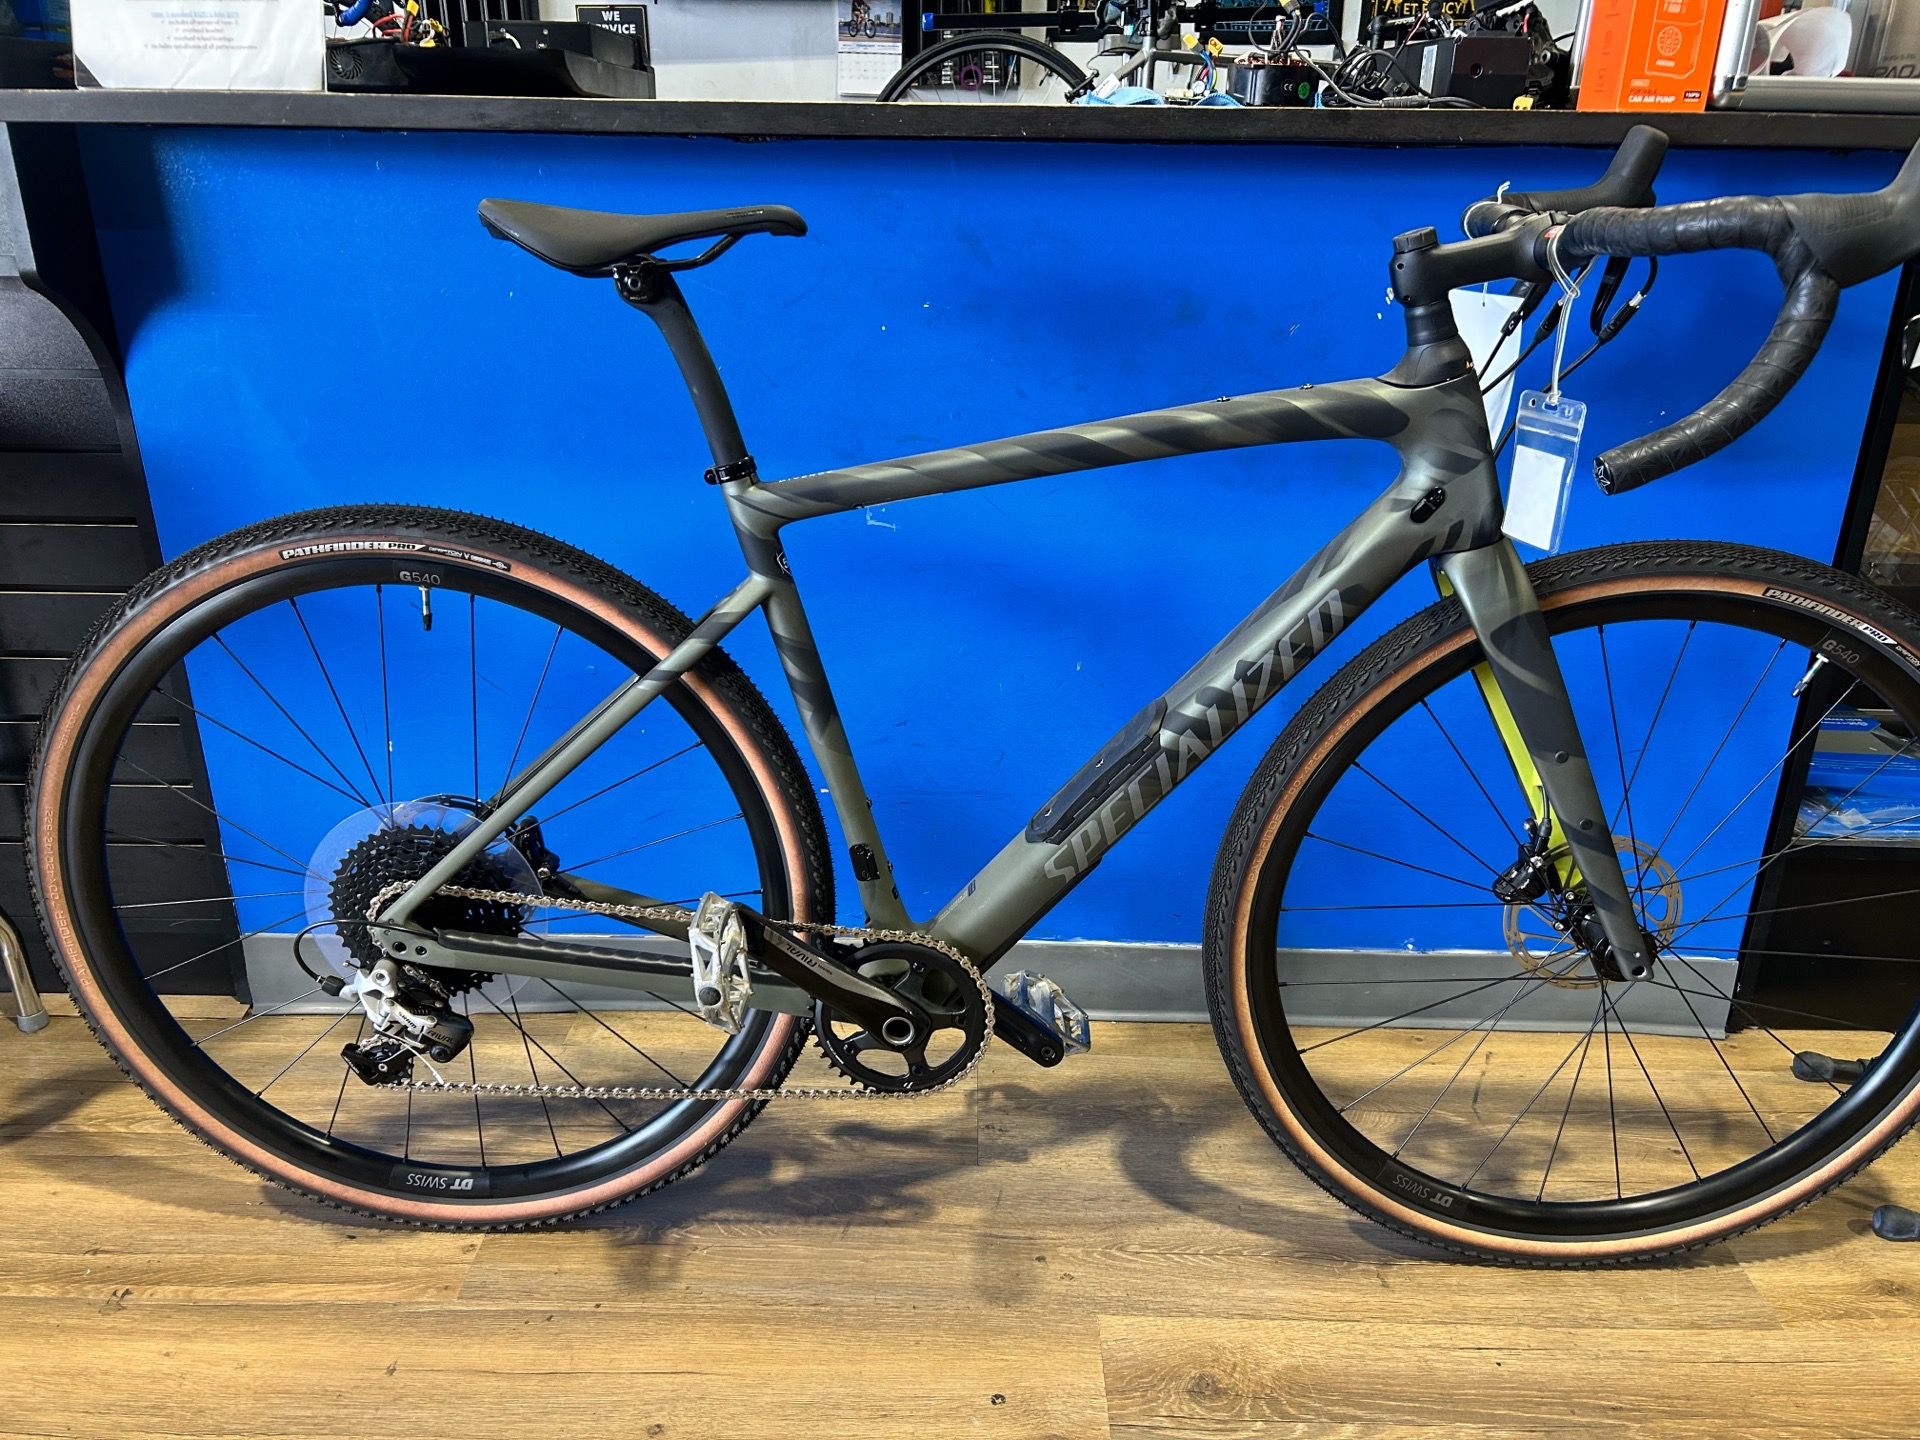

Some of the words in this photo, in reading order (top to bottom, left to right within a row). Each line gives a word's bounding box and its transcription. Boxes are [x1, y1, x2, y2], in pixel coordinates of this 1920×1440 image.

[601, 10, 621, 21] WE
[1628, 95, 1643, 103] CAR
[1643, 95, 1655, 103] AIR
[1655, 95, 1676, 103] PUMP
[282, 541, 388, 560] PATHFINDER
[387, 542, 417, 550] PRO
[399, 570, 441, 585] G540
[1764, 588, 1864, 630] PATHFINDER
[1862, 625, 1889, 643] PRO
[1821, 639, 1861, 665] G540
[1044, 588, 1345, 884] SPECIALIZED
[785, 943, 818, 968] RIVAL
[406, 1173, 448, 1190] SWISS
[450, 1178, 474, 1190] DT
[1392, 1174, 1431, 1199] SWISS
[1430, 1192, 1453, 1208] DT
